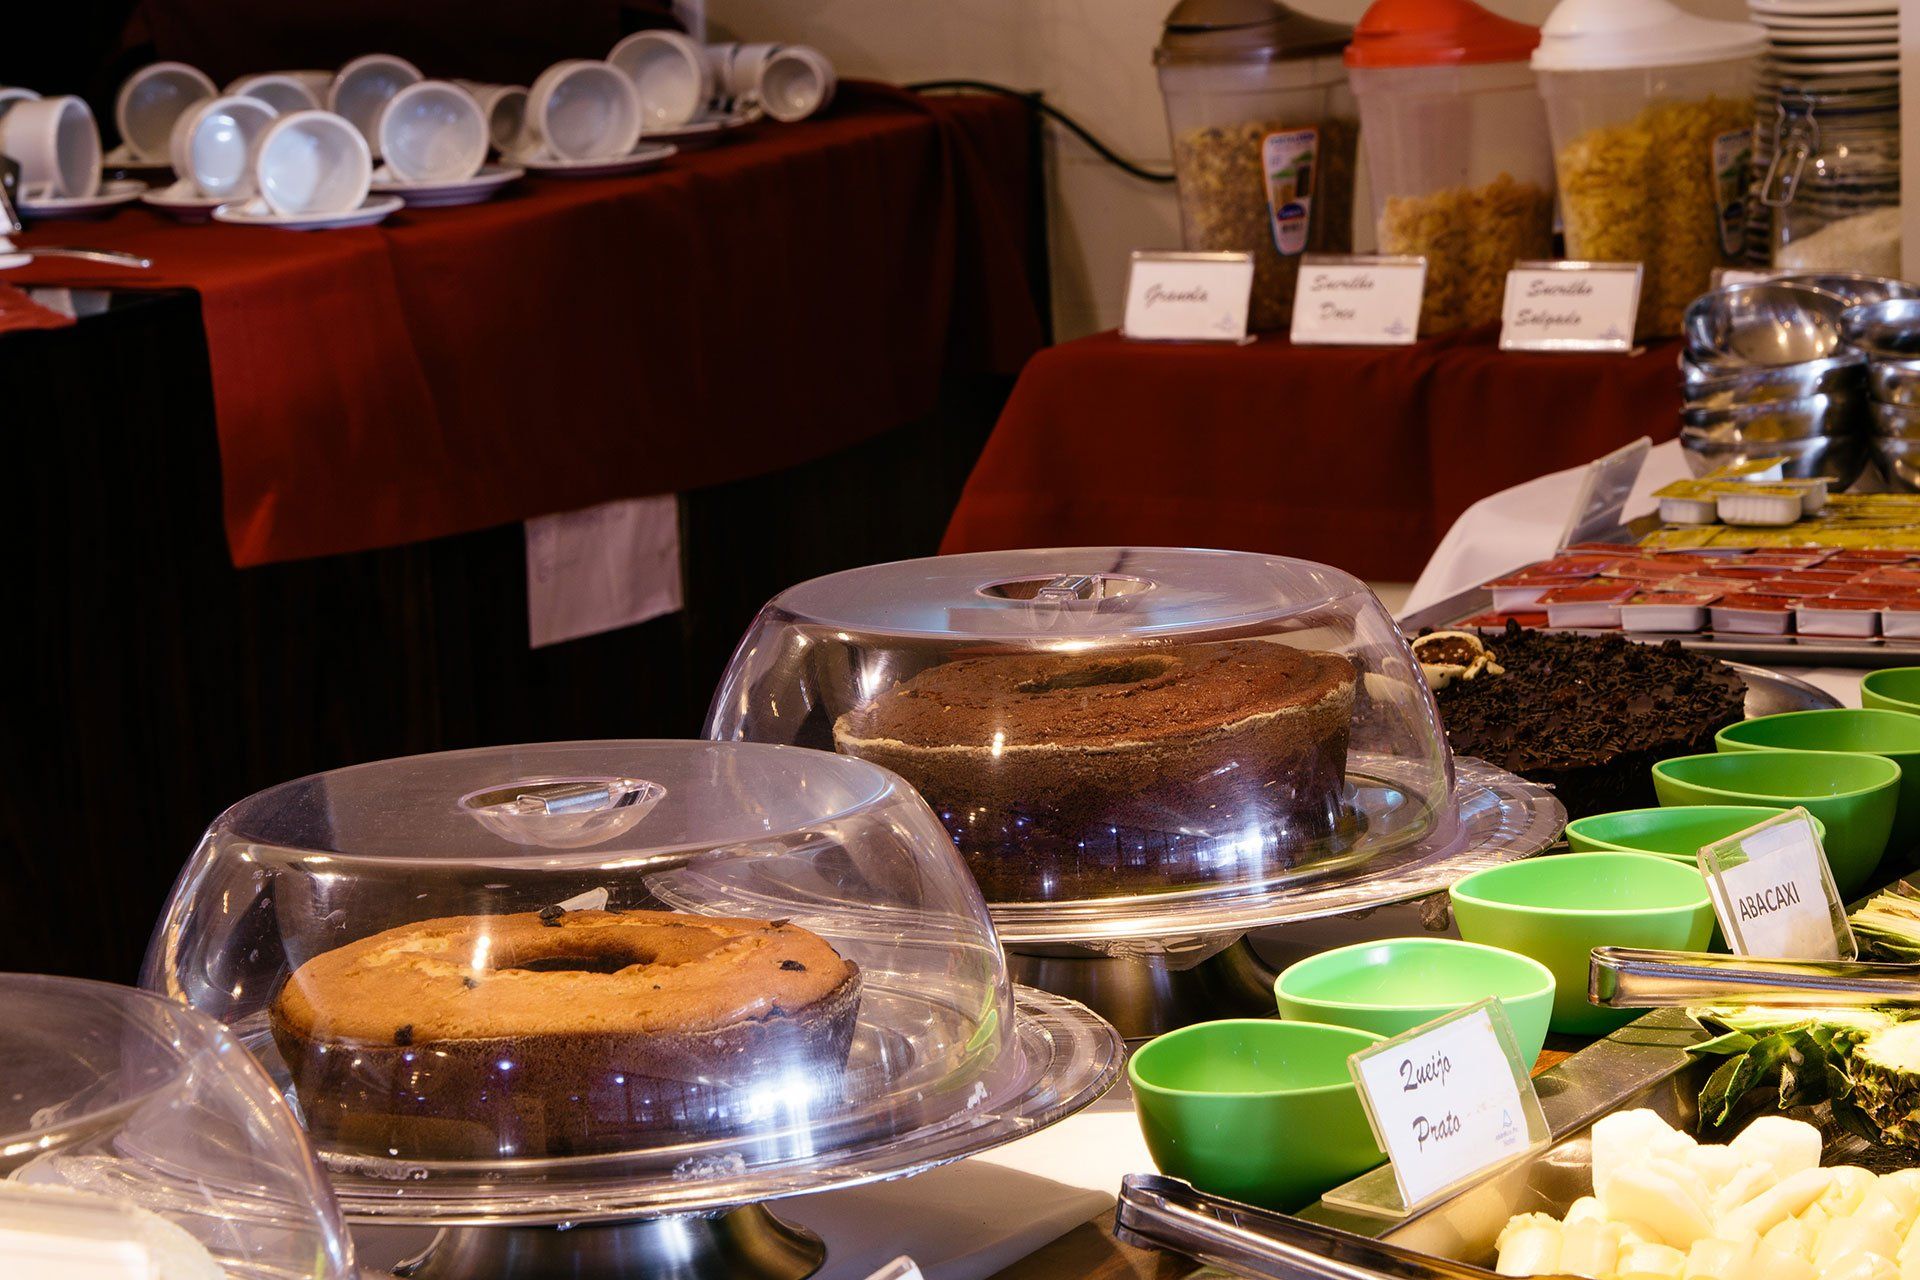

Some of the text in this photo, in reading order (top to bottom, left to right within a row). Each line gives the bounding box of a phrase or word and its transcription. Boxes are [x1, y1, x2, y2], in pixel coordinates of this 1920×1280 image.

[1738, 881, 1801, 922] ABACAXI
[1399, 1050, 1453, 1092] Queijo
[1412, 1110, 1461, 1153] Prato
